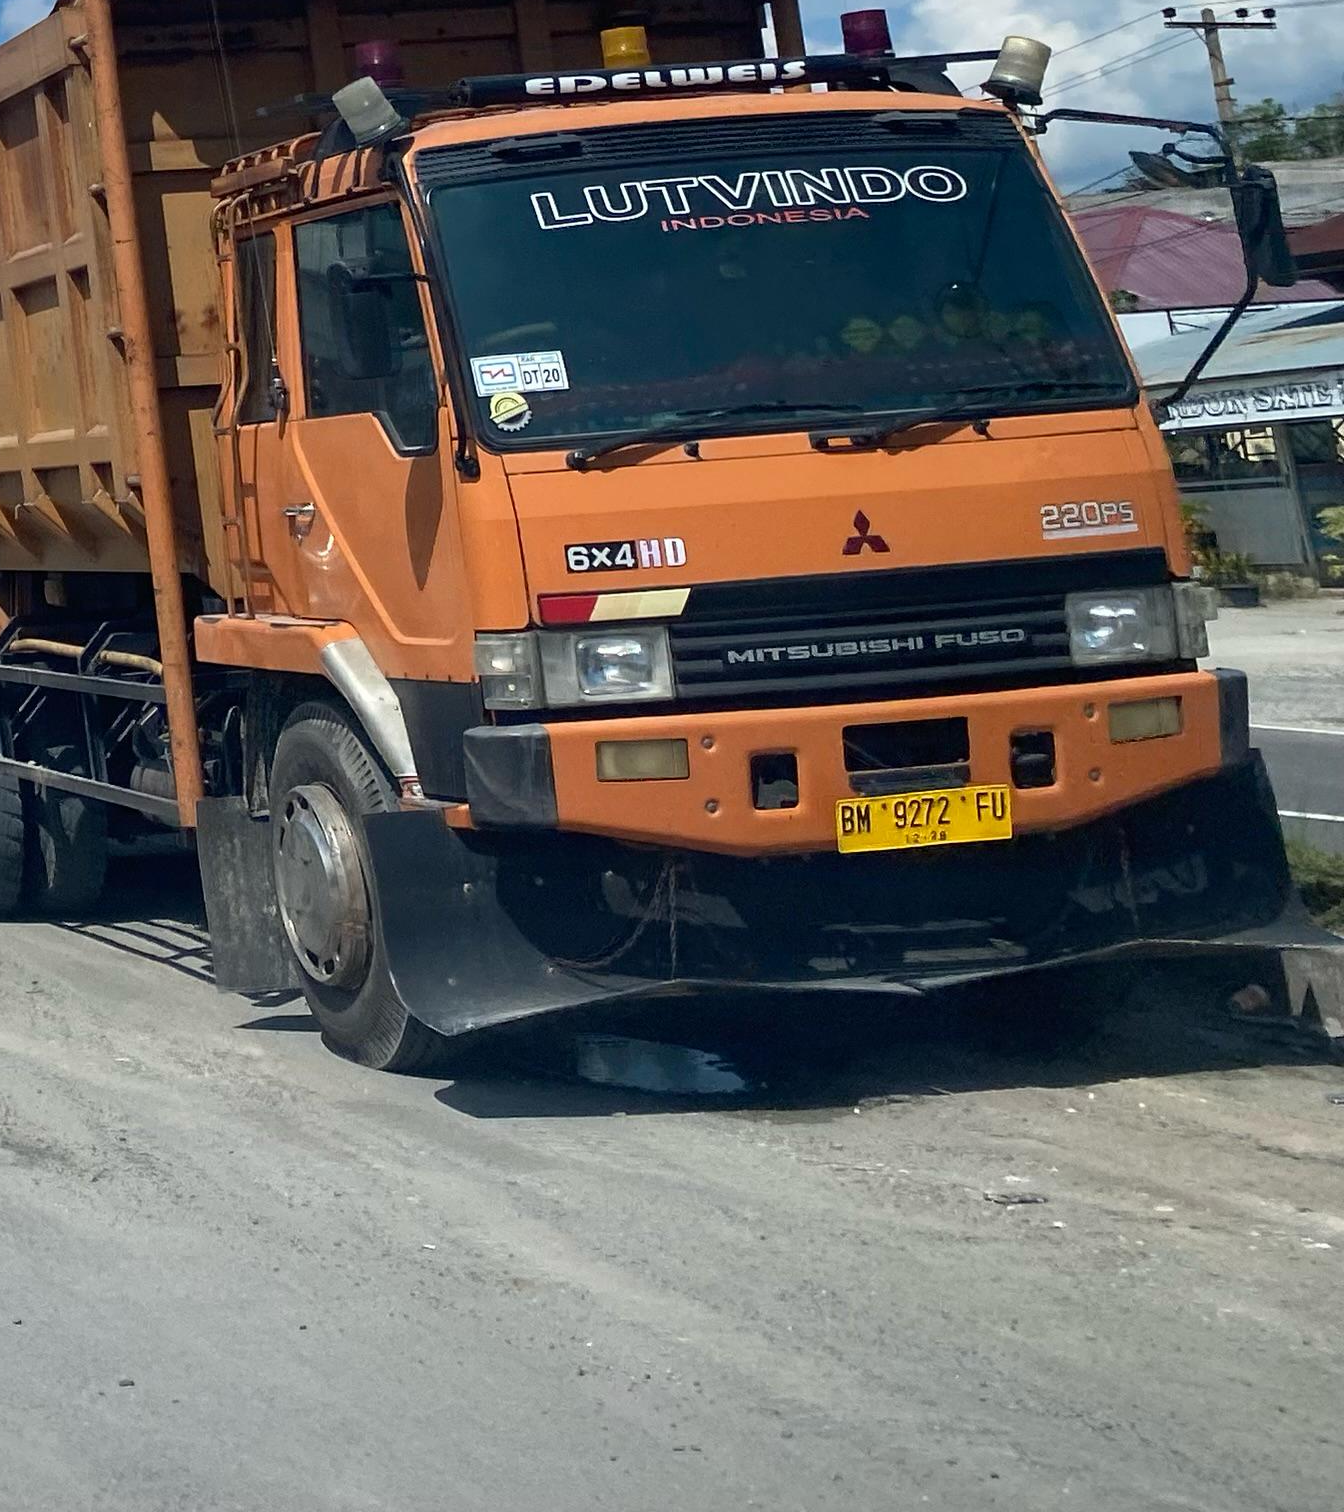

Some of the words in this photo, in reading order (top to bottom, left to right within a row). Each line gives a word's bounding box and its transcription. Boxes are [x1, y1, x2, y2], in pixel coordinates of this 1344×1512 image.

[525, 61, 806, 95] EDELWEIS
[530, 166, 968, 230] LUTVINDO
[661, 207, 870, 232] INDONESIA
[523, 370, 539, 385] DT
[543, 368, 561, 383] 20
[1252, 381, 1333, 412] SATE
[1039, 501, 1135, 530] 220PS
[727, 636, 924, 665] MITSUBISHI
[934, 628, 1026, 650] FUSO
[841, 804, 871, 834] BM
[894, 796, 951, 829] 9272
[976, 791, 1005, 821] FU
